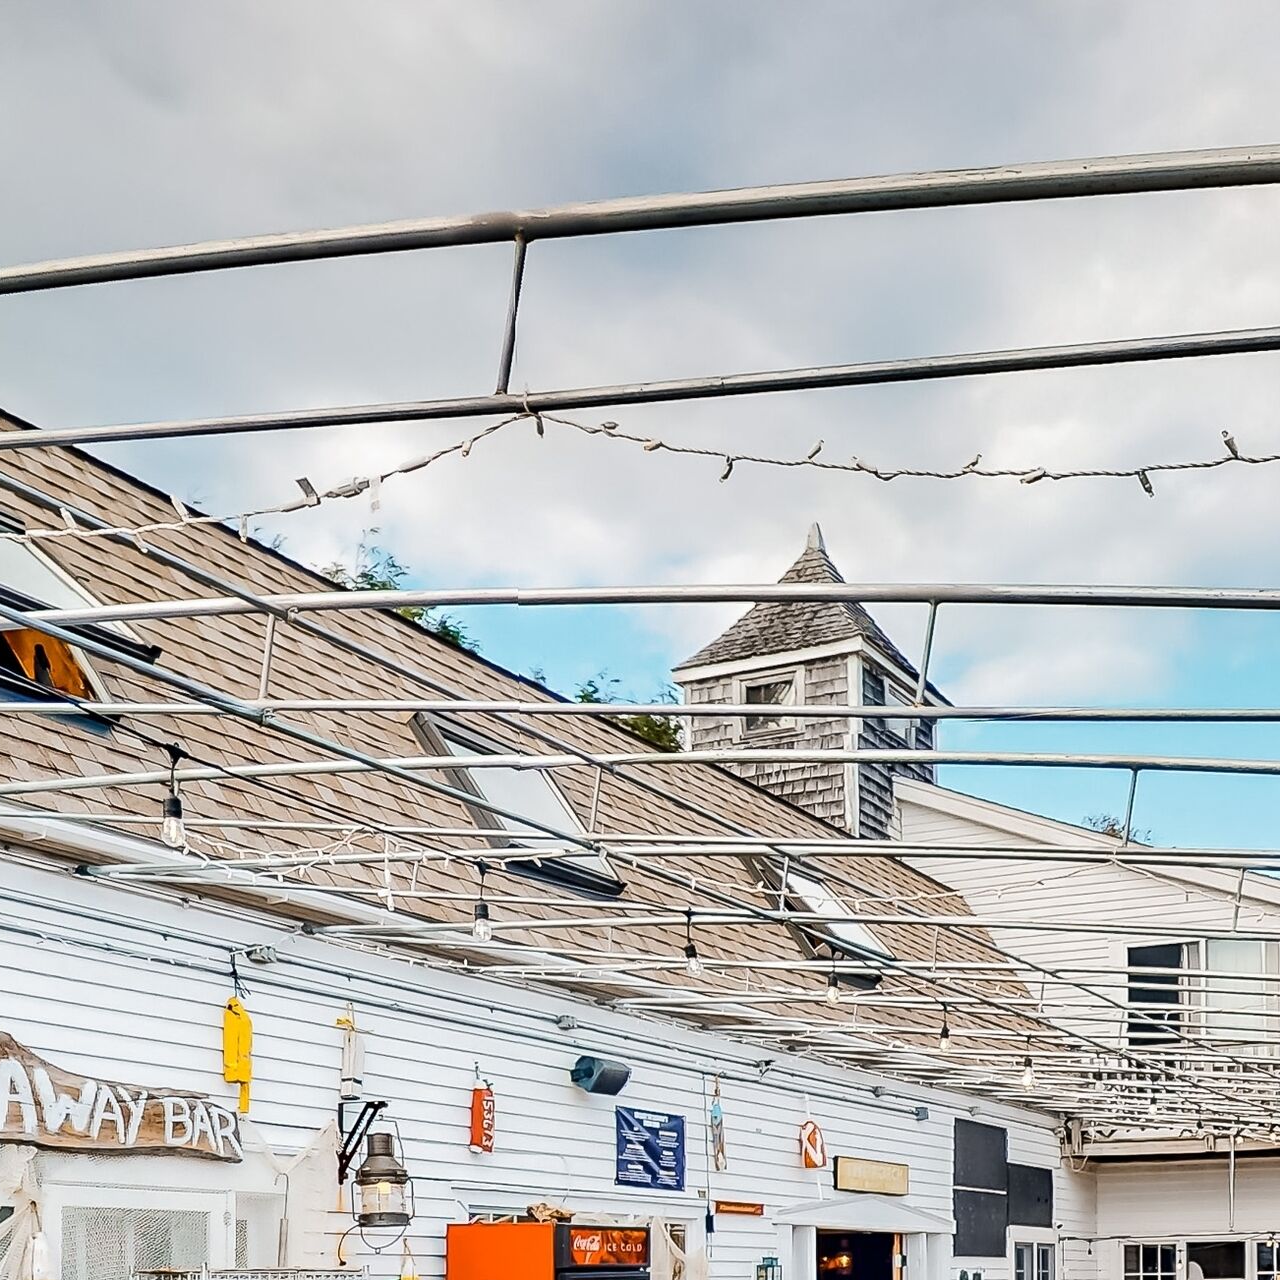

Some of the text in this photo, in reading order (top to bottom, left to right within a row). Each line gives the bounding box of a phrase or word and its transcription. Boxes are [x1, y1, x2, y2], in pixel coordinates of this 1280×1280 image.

[164, 1097, 244, 1158] BAR
[604, 1242, 617, 1252] ICE
[620, 1242, 643, 1252] COLD
